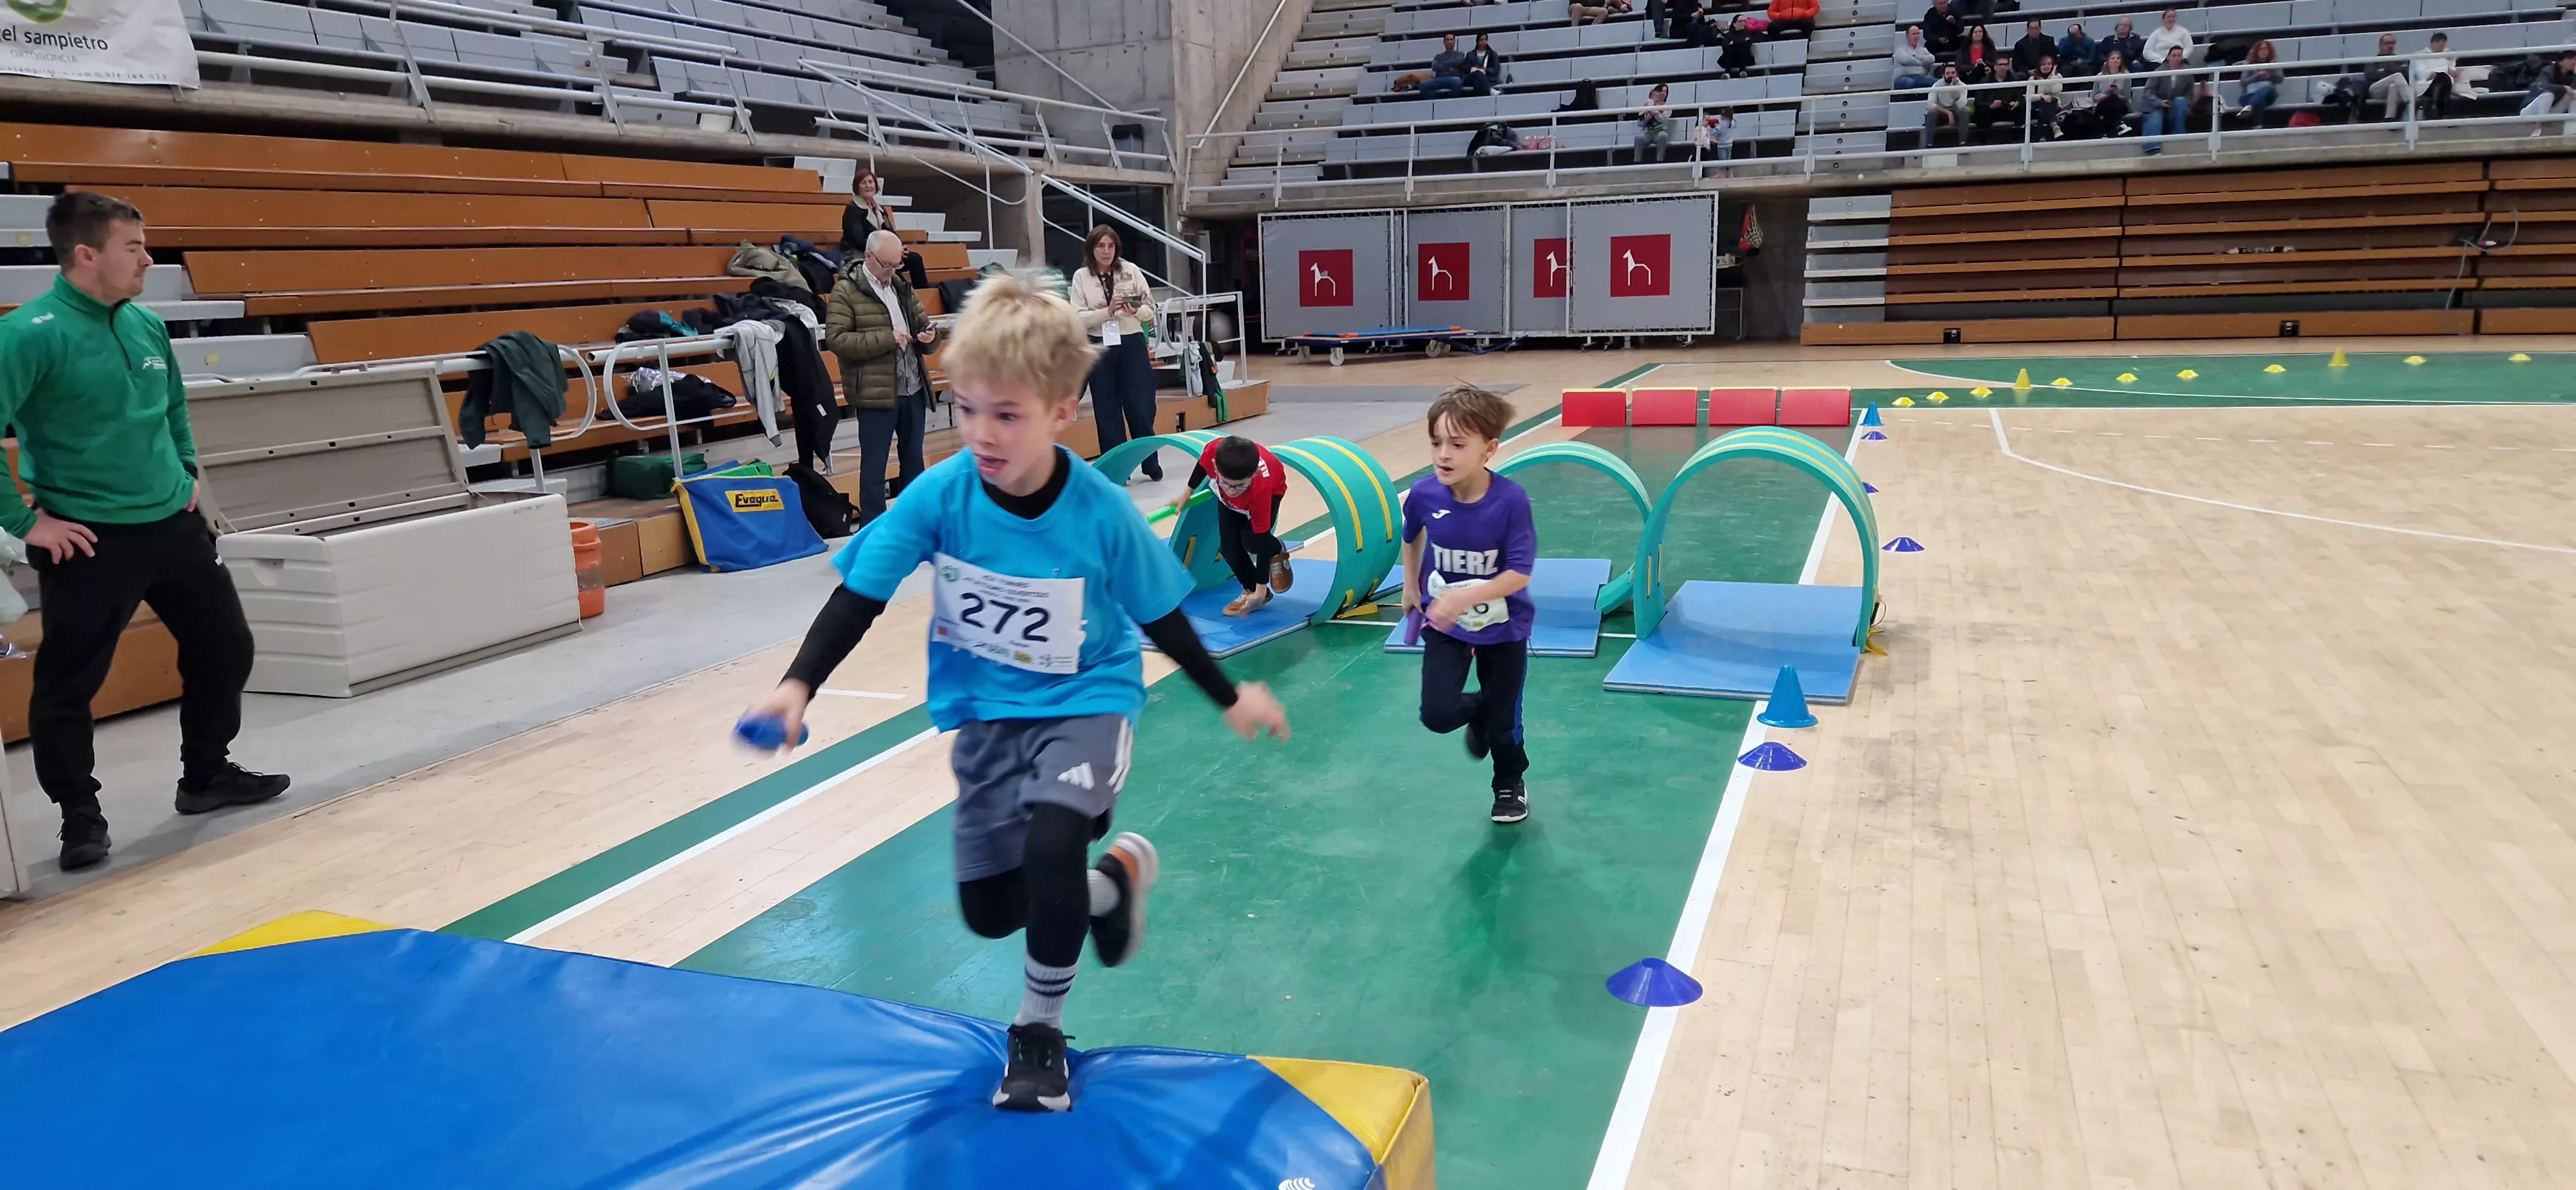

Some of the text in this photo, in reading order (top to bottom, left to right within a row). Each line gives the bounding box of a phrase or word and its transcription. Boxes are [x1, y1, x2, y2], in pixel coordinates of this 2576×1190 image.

[0, 25, 108, 50] el sampietro
[1430, 542, 1499, 575] TIERZ
[960, 592, 1049, 642] 272
